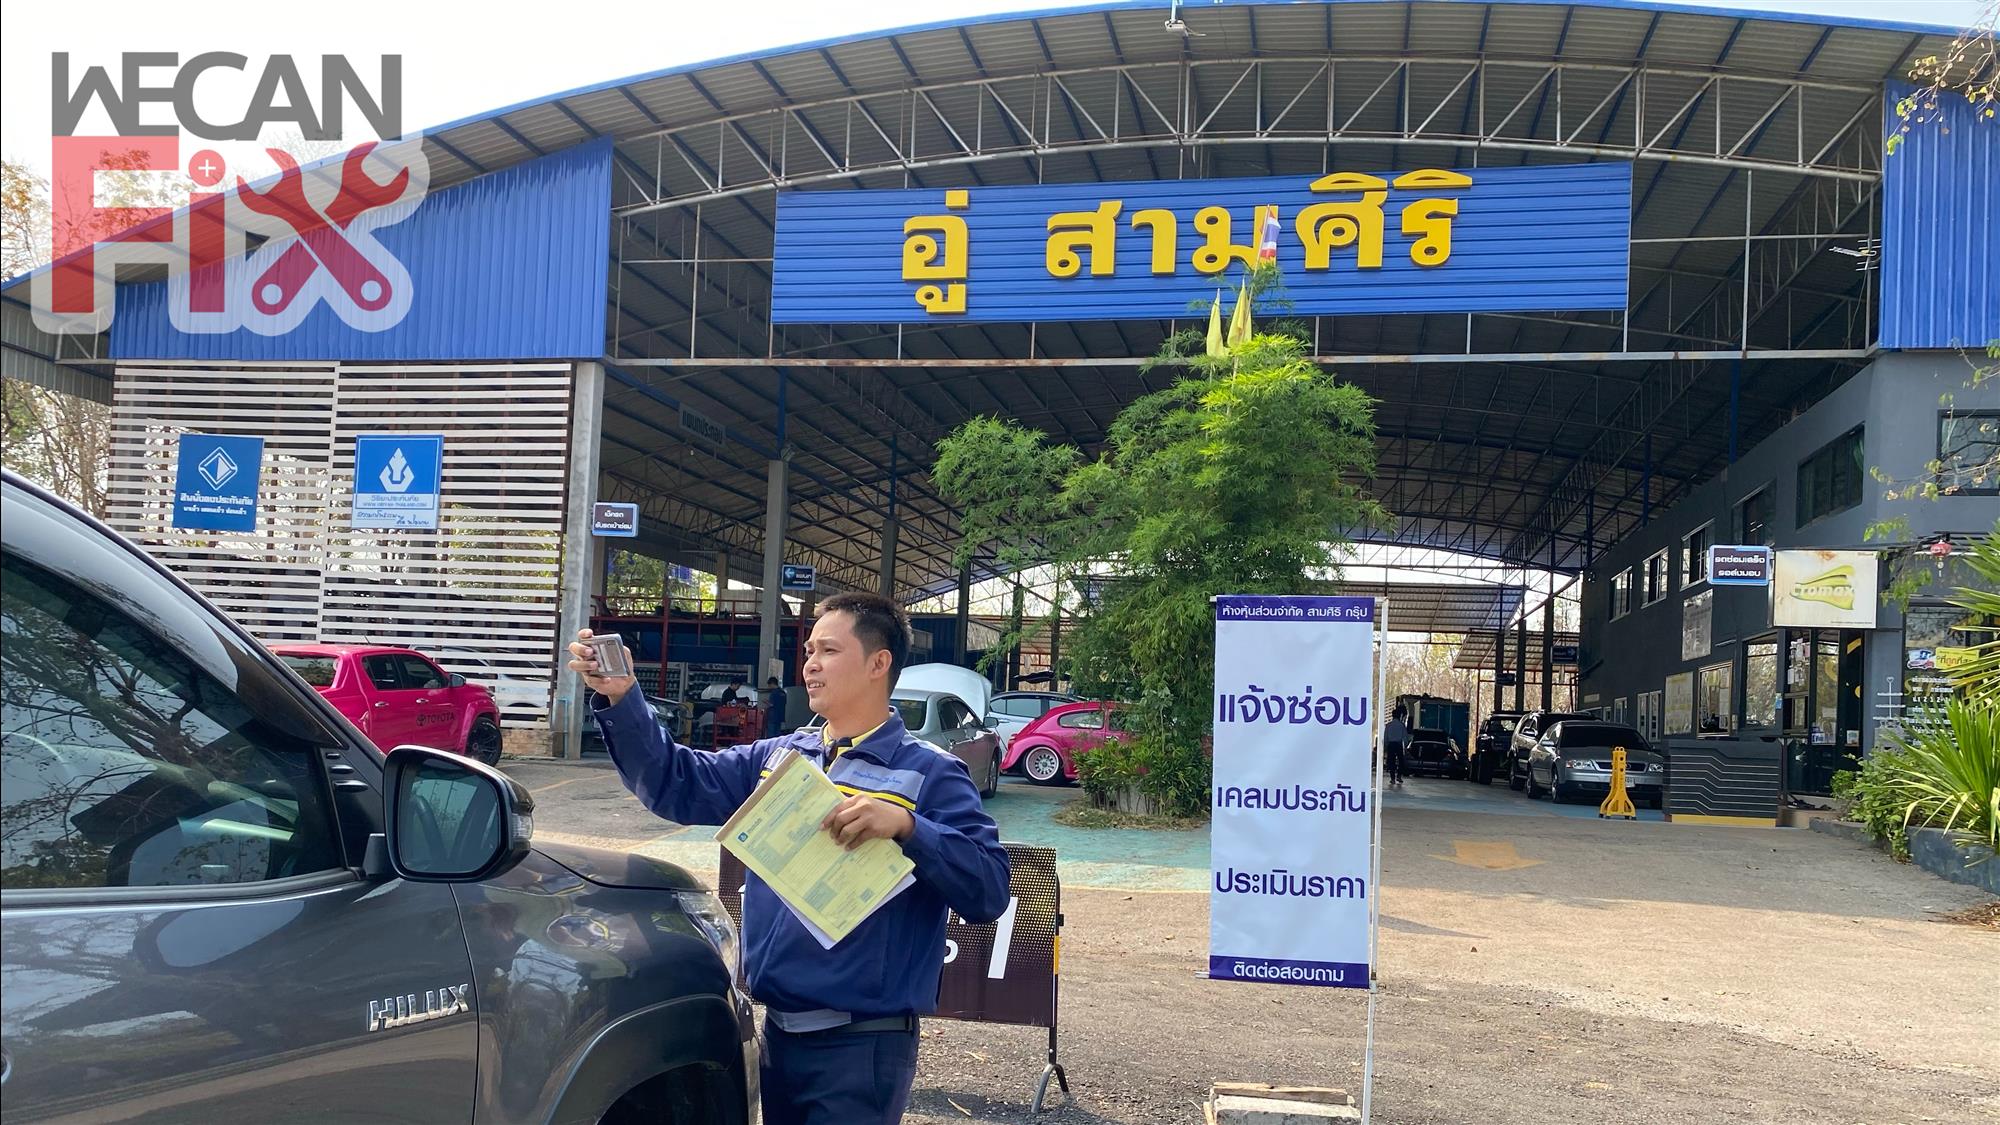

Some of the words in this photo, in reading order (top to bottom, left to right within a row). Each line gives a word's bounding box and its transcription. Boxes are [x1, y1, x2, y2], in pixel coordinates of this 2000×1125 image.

[902, 189, 968, 314] อู่
[1045, 168, 1473, 277] สามศิริ
[1718, 568, 1761, 578] รอส่งมอบ
[1222, 605, 1304, 619] ห้างหุ้นส่วนจำกัด
[1307, 606, 1342, 617] สามศิริ
[1345, 605, 1369, 620] กรุ๊ป
[427, 711, 456, 724] TOYOTA
[1219, 685, 1367, 726] แจ้งซ่อม
[1217, 783, 1366, 813] เคลมประกัน
[1215, 867, 1365, 900] ประเมินราคา
[1233, 960, 1345, 983] ติดต่อสอบถาม
[368, 983, 470, 1032] HILUX
